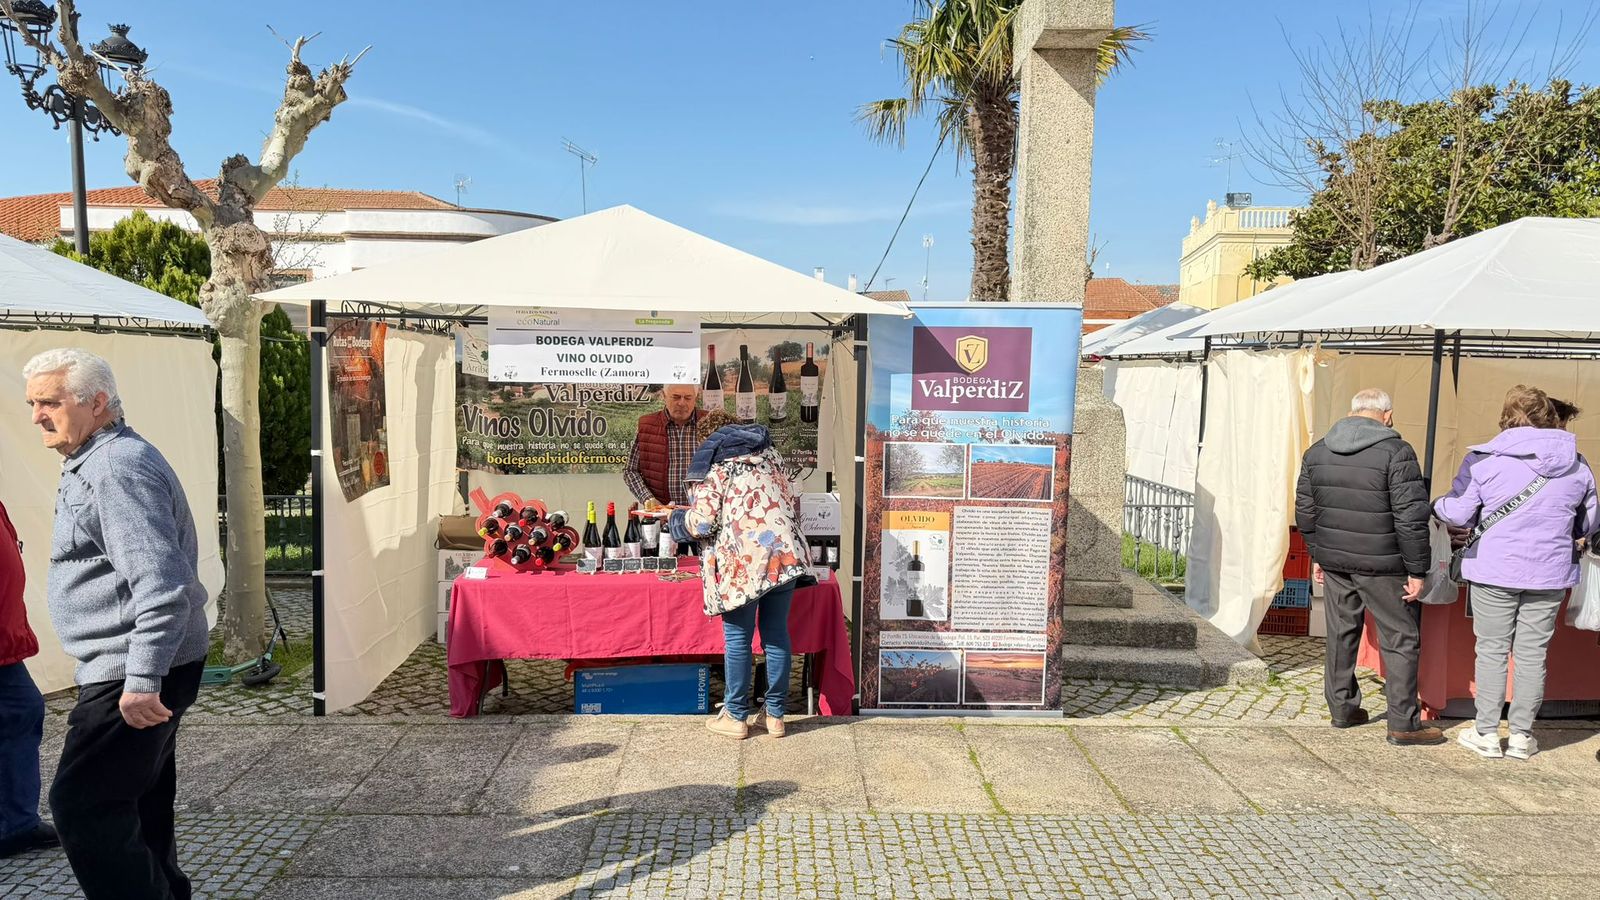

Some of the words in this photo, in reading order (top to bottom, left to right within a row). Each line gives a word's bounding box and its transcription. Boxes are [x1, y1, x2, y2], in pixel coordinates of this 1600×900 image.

[536, 336, 585, 345] BODEGA
[587, 336, 654, 346] VALPERDIZ
[556, 353, 586, 362] VINO
[589, 354, 633, 363] OLVIDO
[541, 366, 598, 376] Fermoselle
[600, 368, 650, 378] (Zamora)
[544, 384, 651, 408] ValperdiZ
[918, 379, 1024, 404] ValperdiZ
[462, 404, 521, 438] Vinos
[528, 408, 607, 438] Olvido
[891, 414, 918, 425] Para
[921, 417, 946, 427] que
[950, 417, 998, 426] nuestra
[1002, 417, 1049, 428] historia
[921, 428, 962, 440] quede
[986, 429, 997, 438] el
[462, 436, 480, 446] Para
[482, 441, 494, 450] que
[528, 441, 556, 450] historia
[584, 441, 604, 451] quede
[487, 452, 628, 468] bodegasolvidofermose
[1528, 476, 1546, 493] BIMB
[1506, 494, 1527, 510] LOLA
